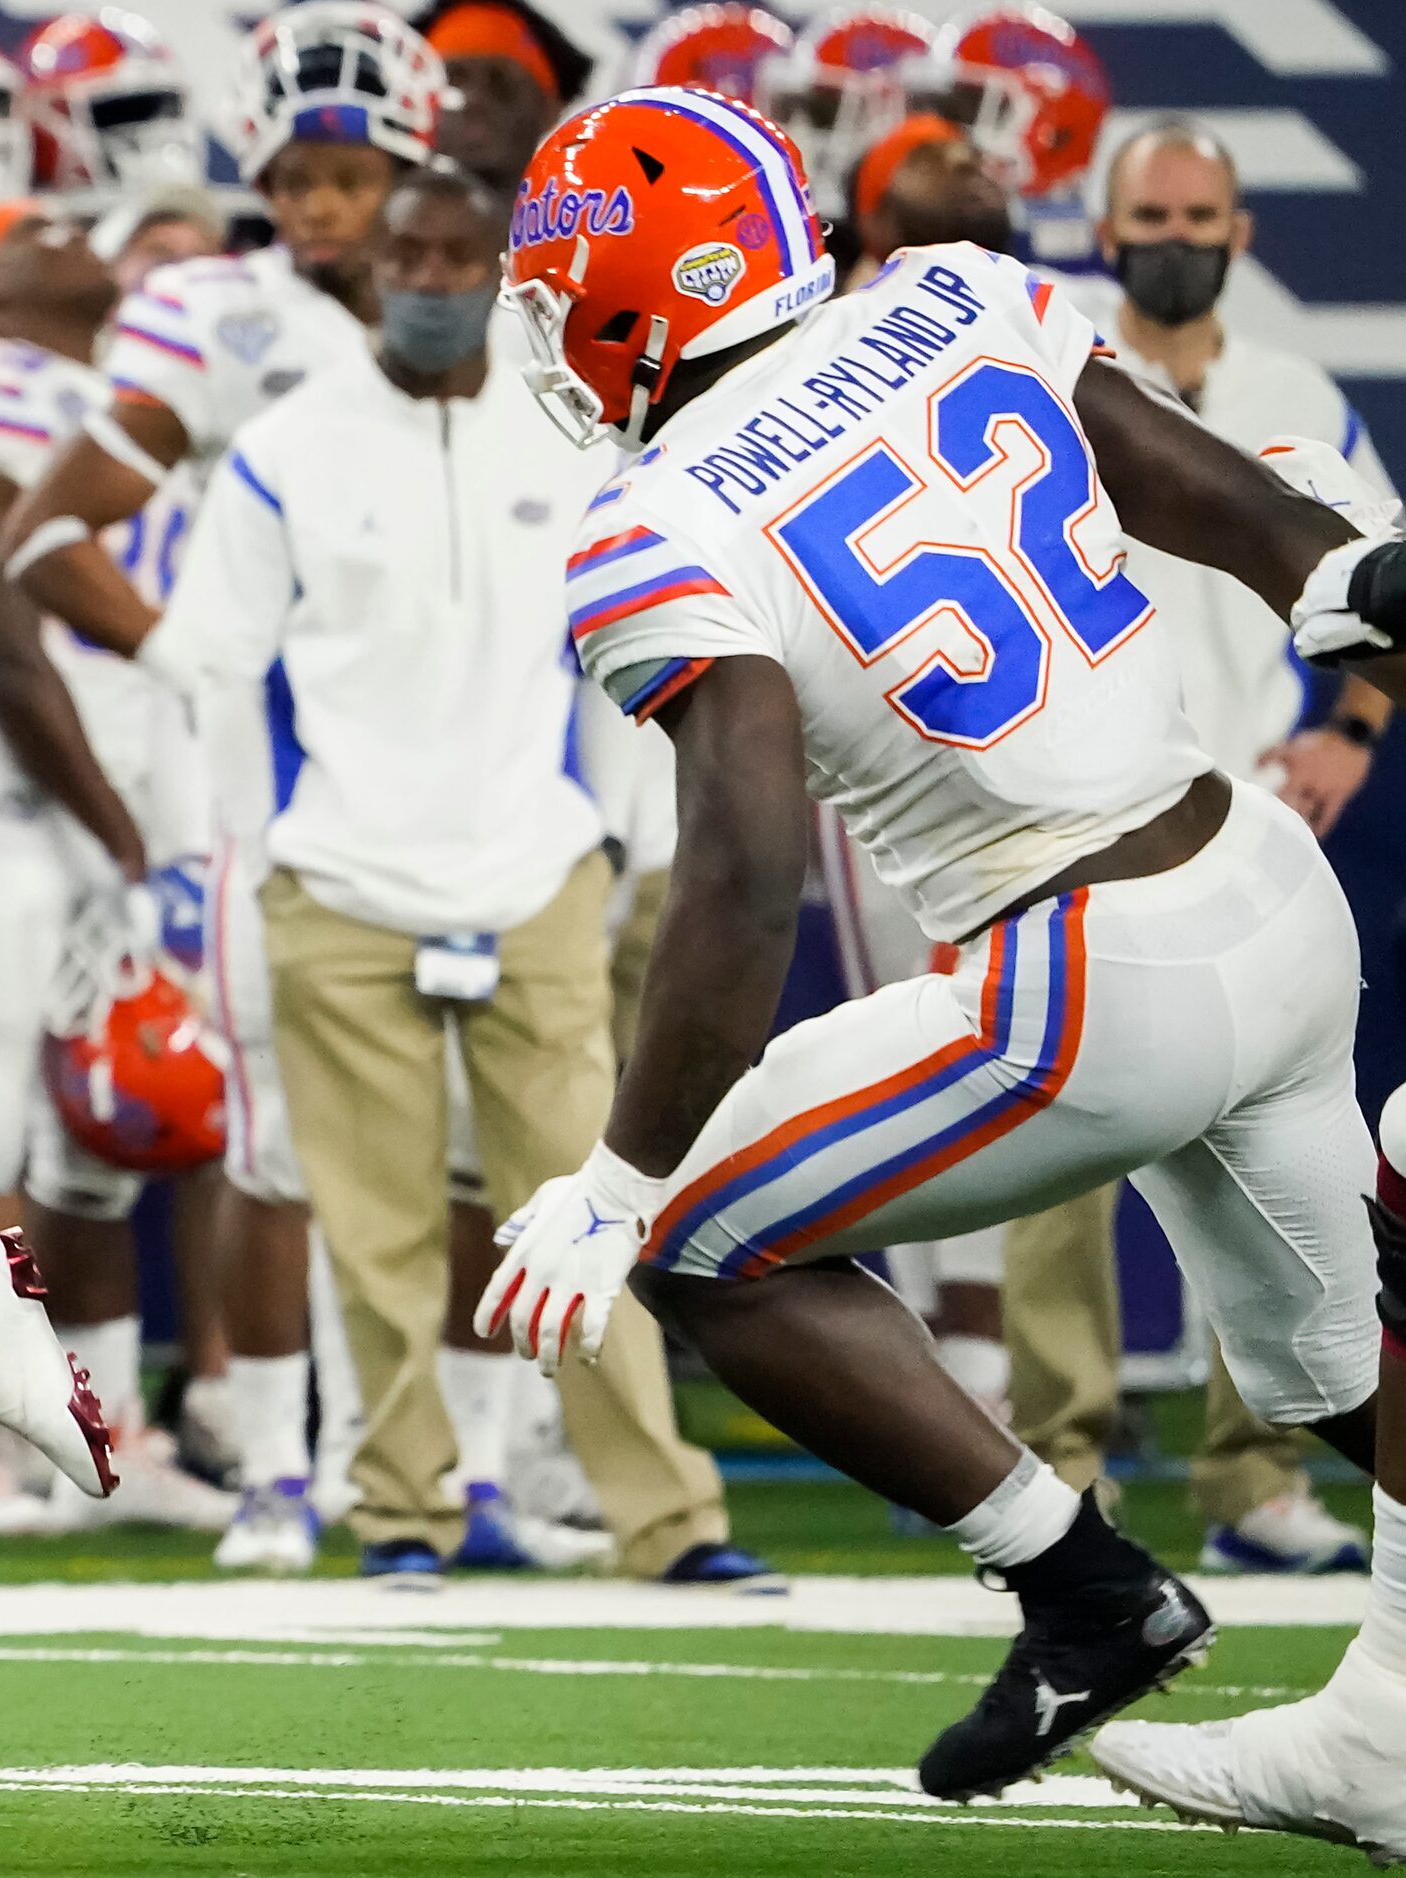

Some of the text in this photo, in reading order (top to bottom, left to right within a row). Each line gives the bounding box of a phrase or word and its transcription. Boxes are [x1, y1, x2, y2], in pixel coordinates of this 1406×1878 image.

[509, 176, 635, 251] Gators
[684, 265, 986, 515] POWELL-RYLAND JR
[762, 355, 1156, 752] 52
